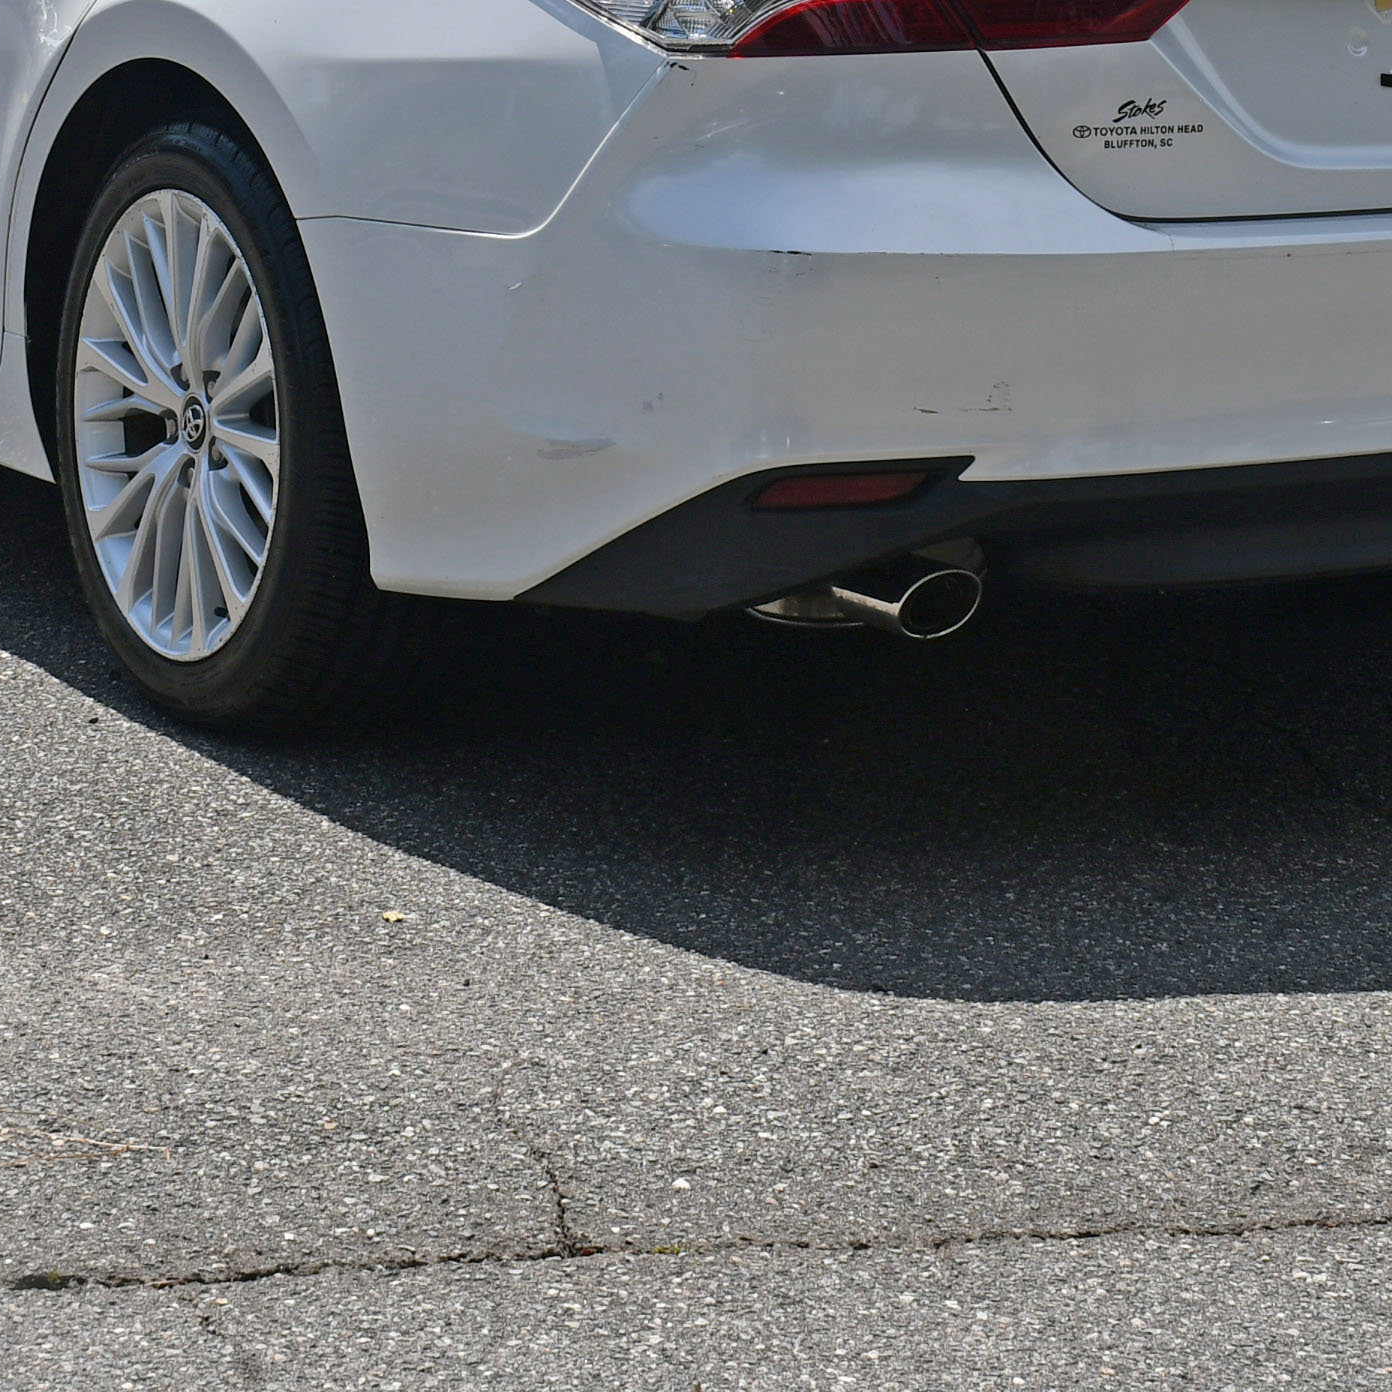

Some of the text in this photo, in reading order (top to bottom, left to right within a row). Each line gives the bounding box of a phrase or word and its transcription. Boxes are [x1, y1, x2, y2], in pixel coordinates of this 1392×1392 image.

[1112, 98, 1167, 123] Stokes
[1093, 124, 1203, 137] TOYOTA HILTON HEAD
[1104, 138, 1173, 149] BLUFFTON, SC
